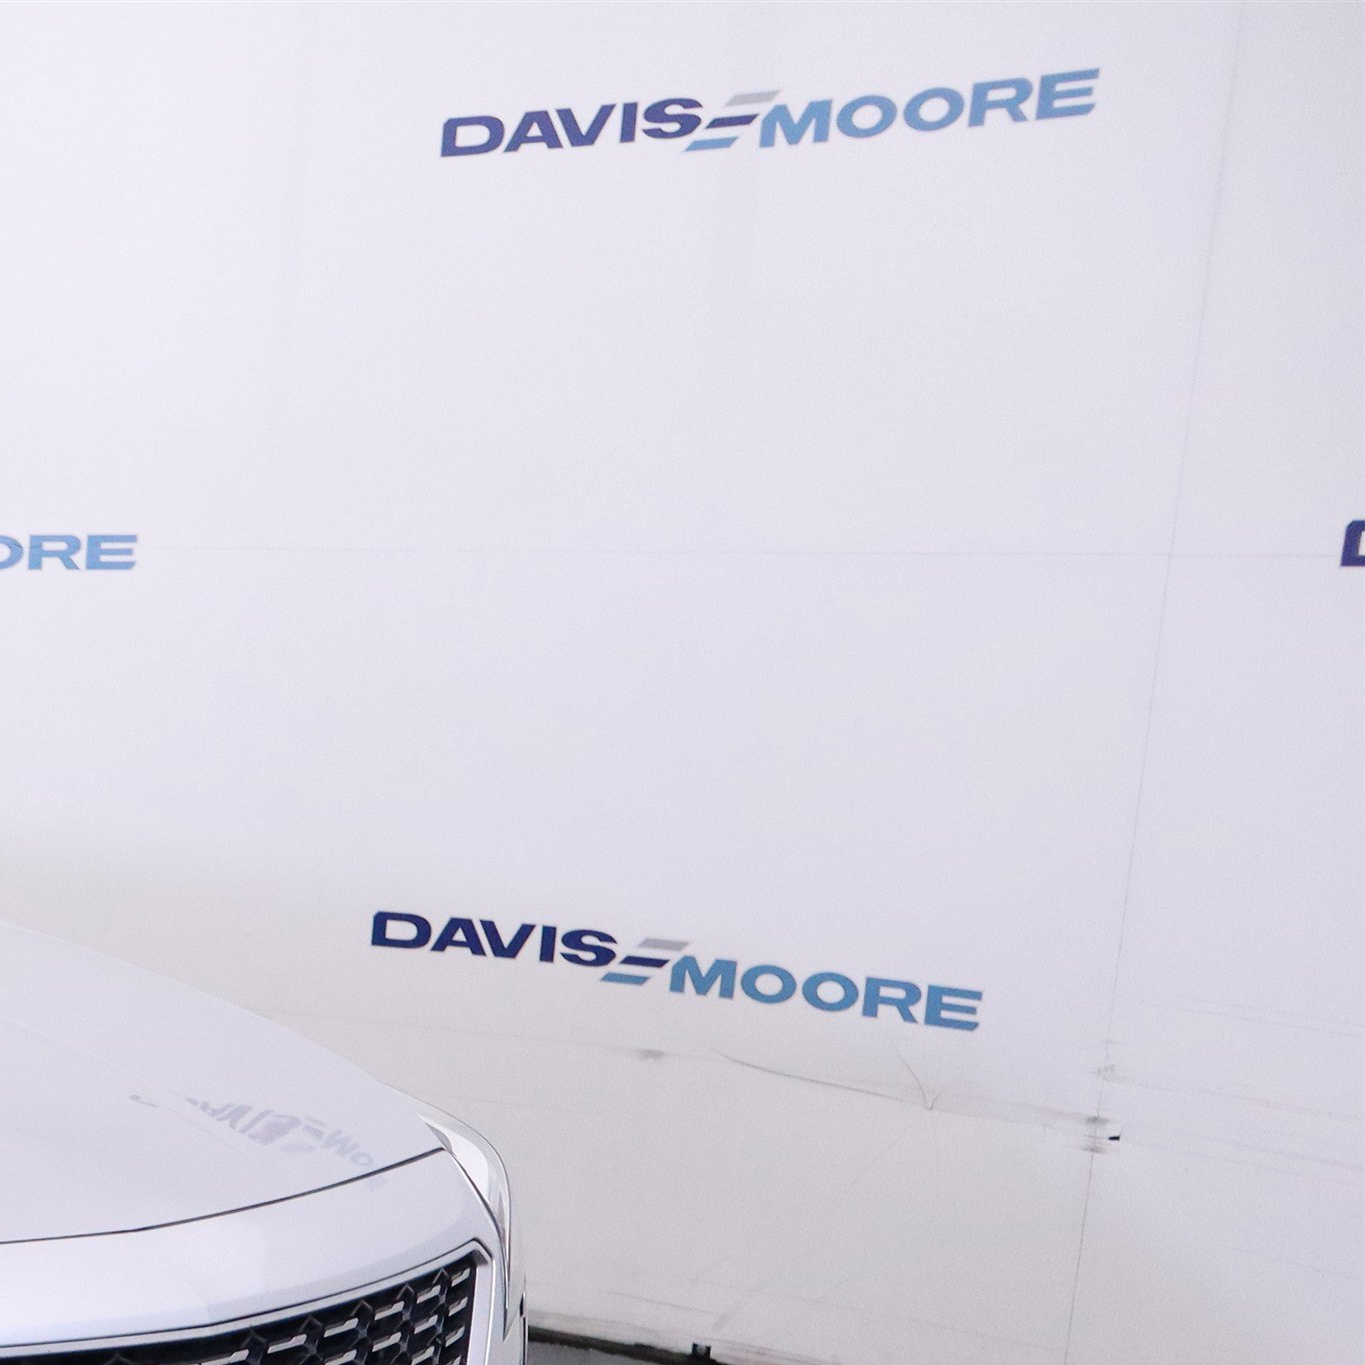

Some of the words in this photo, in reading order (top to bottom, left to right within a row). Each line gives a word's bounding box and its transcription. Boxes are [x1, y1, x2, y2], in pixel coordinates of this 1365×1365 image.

[440, 97, 700, 157] DAVIS
[759, 68, 1100, 149] MOORE
[370, 910, 617, 967] DAVIS
[669, 955, 983, 1031] MOORE
